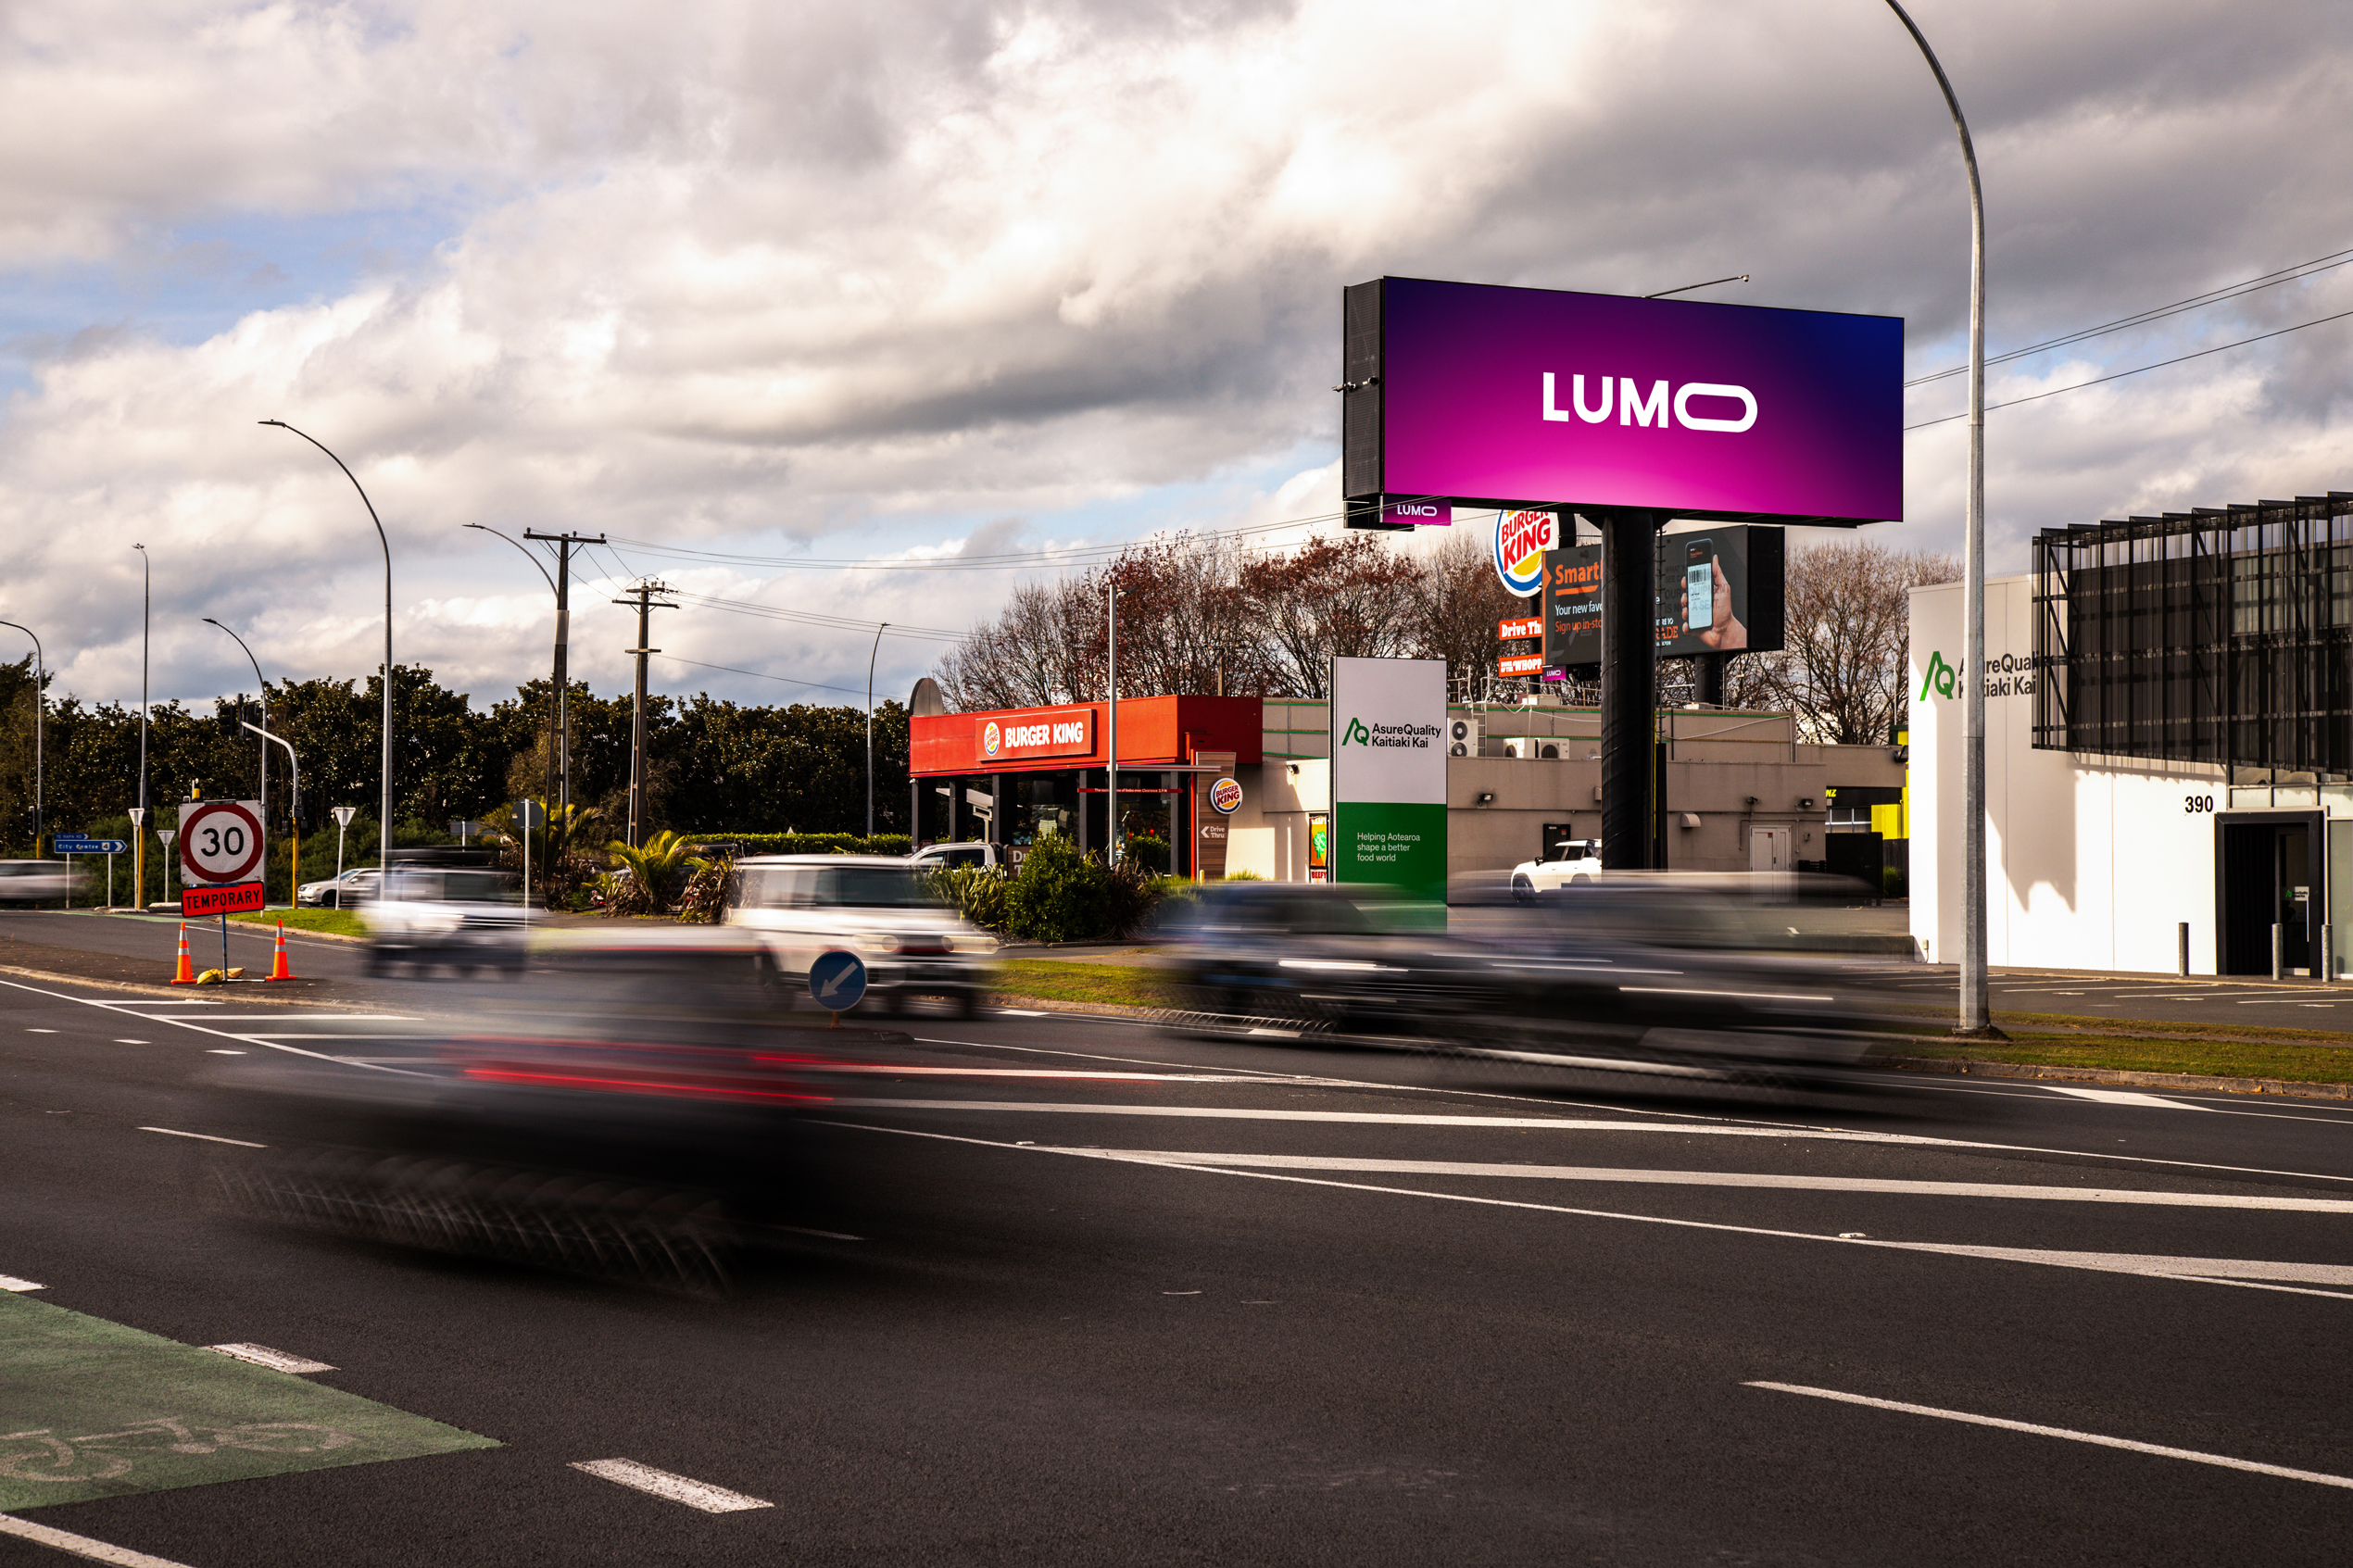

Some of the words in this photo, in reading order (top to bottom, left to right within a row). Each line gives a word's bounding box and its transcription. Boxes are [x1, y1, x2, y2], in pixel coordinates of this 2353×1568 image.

[1542, 371, 1758, 433] LUMO
[1397, 504, 1438, 516] LUMO
[1504, 518, 1551, 572] KING
[1555, 559, 1603, 584] Smart
[1554, 604, 1572, 616] Your
[1572, 604, 1588, 614] new
[1501, 621, 1526, 637] Drive
[1554, 621, 1571, 634] Sign
[1572, 621, 1581, 633] up
[1513, 658, 1542, 671] WHOPP
[2014, 674, 2036, 696] Kai
[1005, 724, 1050, 747] BURGER
[1052, 721, 1084, 744] KING
[1372, 722, 1441, 738] AsureQuality
[1372, 735, 1410, 747] Kaitiaki
[1412, 736, 1428, 748] Kai
[1215, 784, 1239, 797] BURGER
[1216, 791, 1240, 806] KING
[2184, 795, 2214, 813] 390
[201, 827, 245, 857] 30
[1357, 832, 1386, 843] Helping
[1387, 833, 1421, 841] Aotearoa
[1357, 843, 1380, 853] shape
[1388, 843, 1411, 851] better
[1357, 853, 1374, 861] food
[1376, 853, 1396, 862] world
[1312, 871, 1327, 879] BEEFY
[185, 890, 260, 909] TEMPORARY
